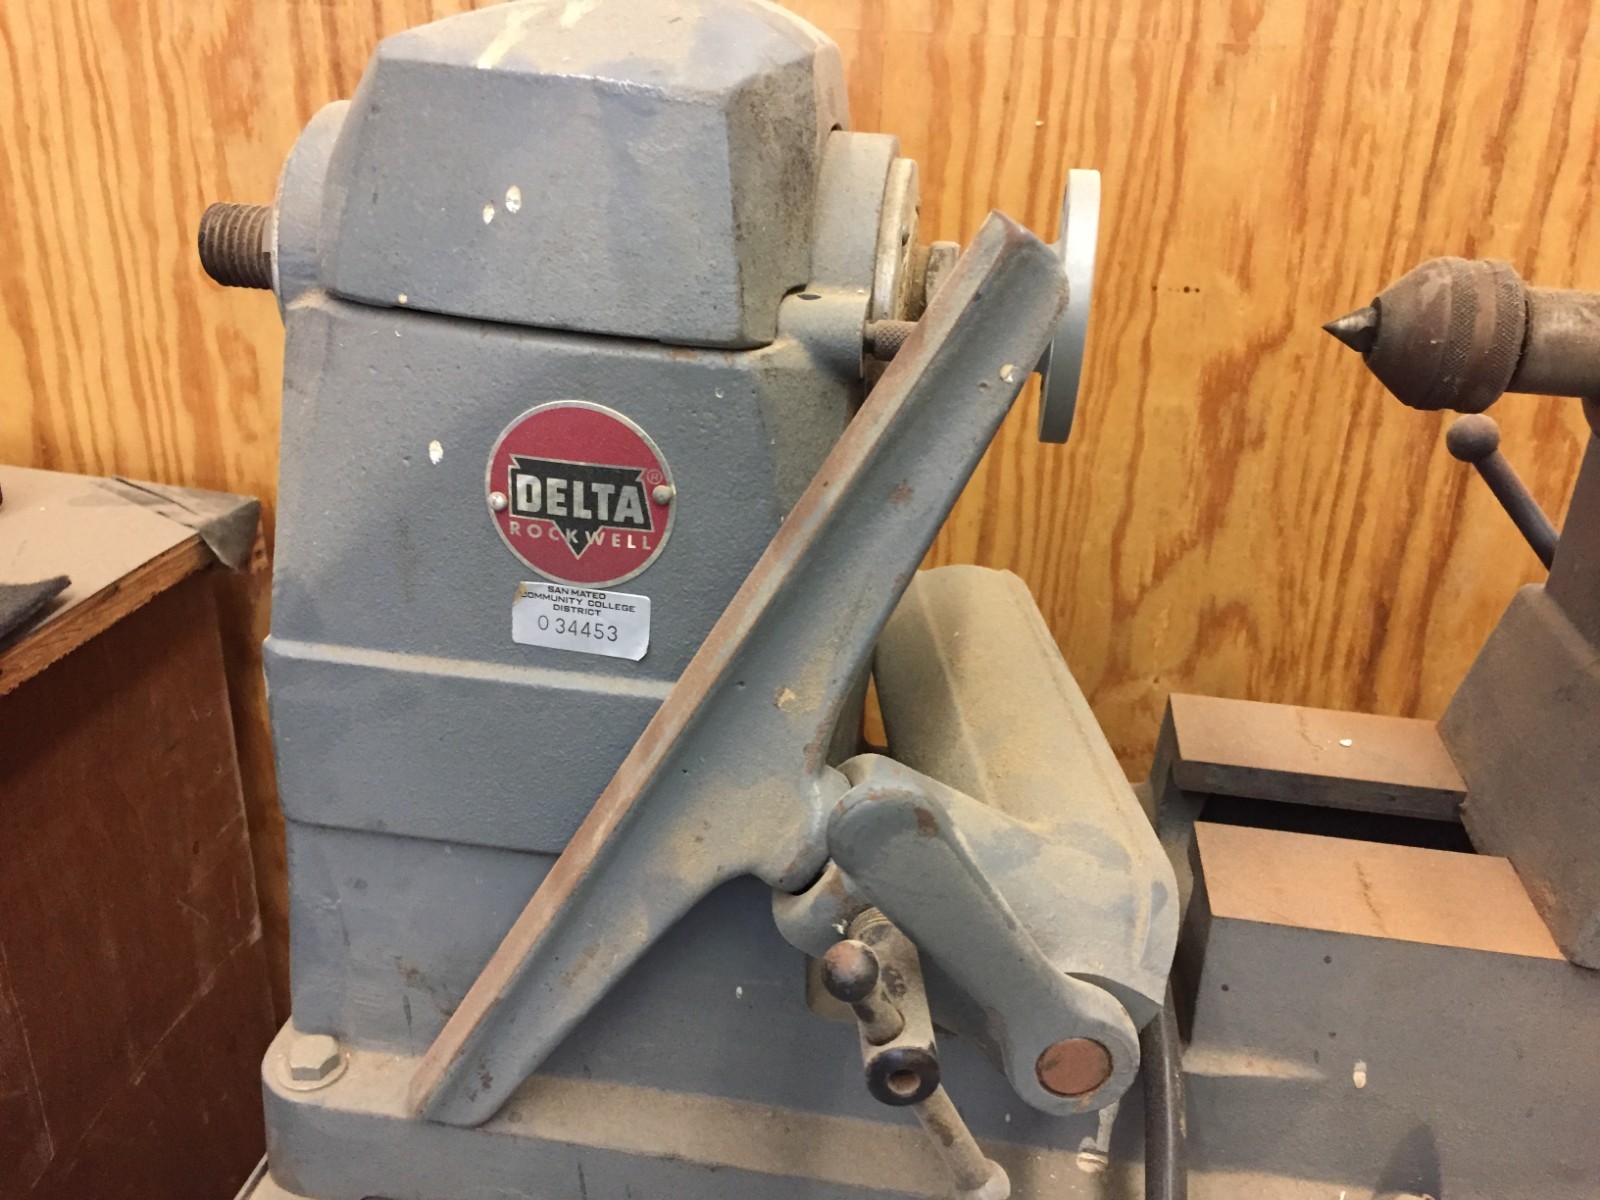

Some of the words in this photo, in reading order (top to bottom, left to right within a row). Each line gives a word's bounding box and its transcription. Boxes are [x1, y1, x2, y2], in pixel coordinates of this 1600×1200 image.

[516, 474, 645, 524] DELTA
[509, 521, 651, 550] ROCKWELL
[548, 586, 569, 595] SAN
[553, 604, 601, 616] DISTRICT
[588, 600, 636, 613] COLLEGE
